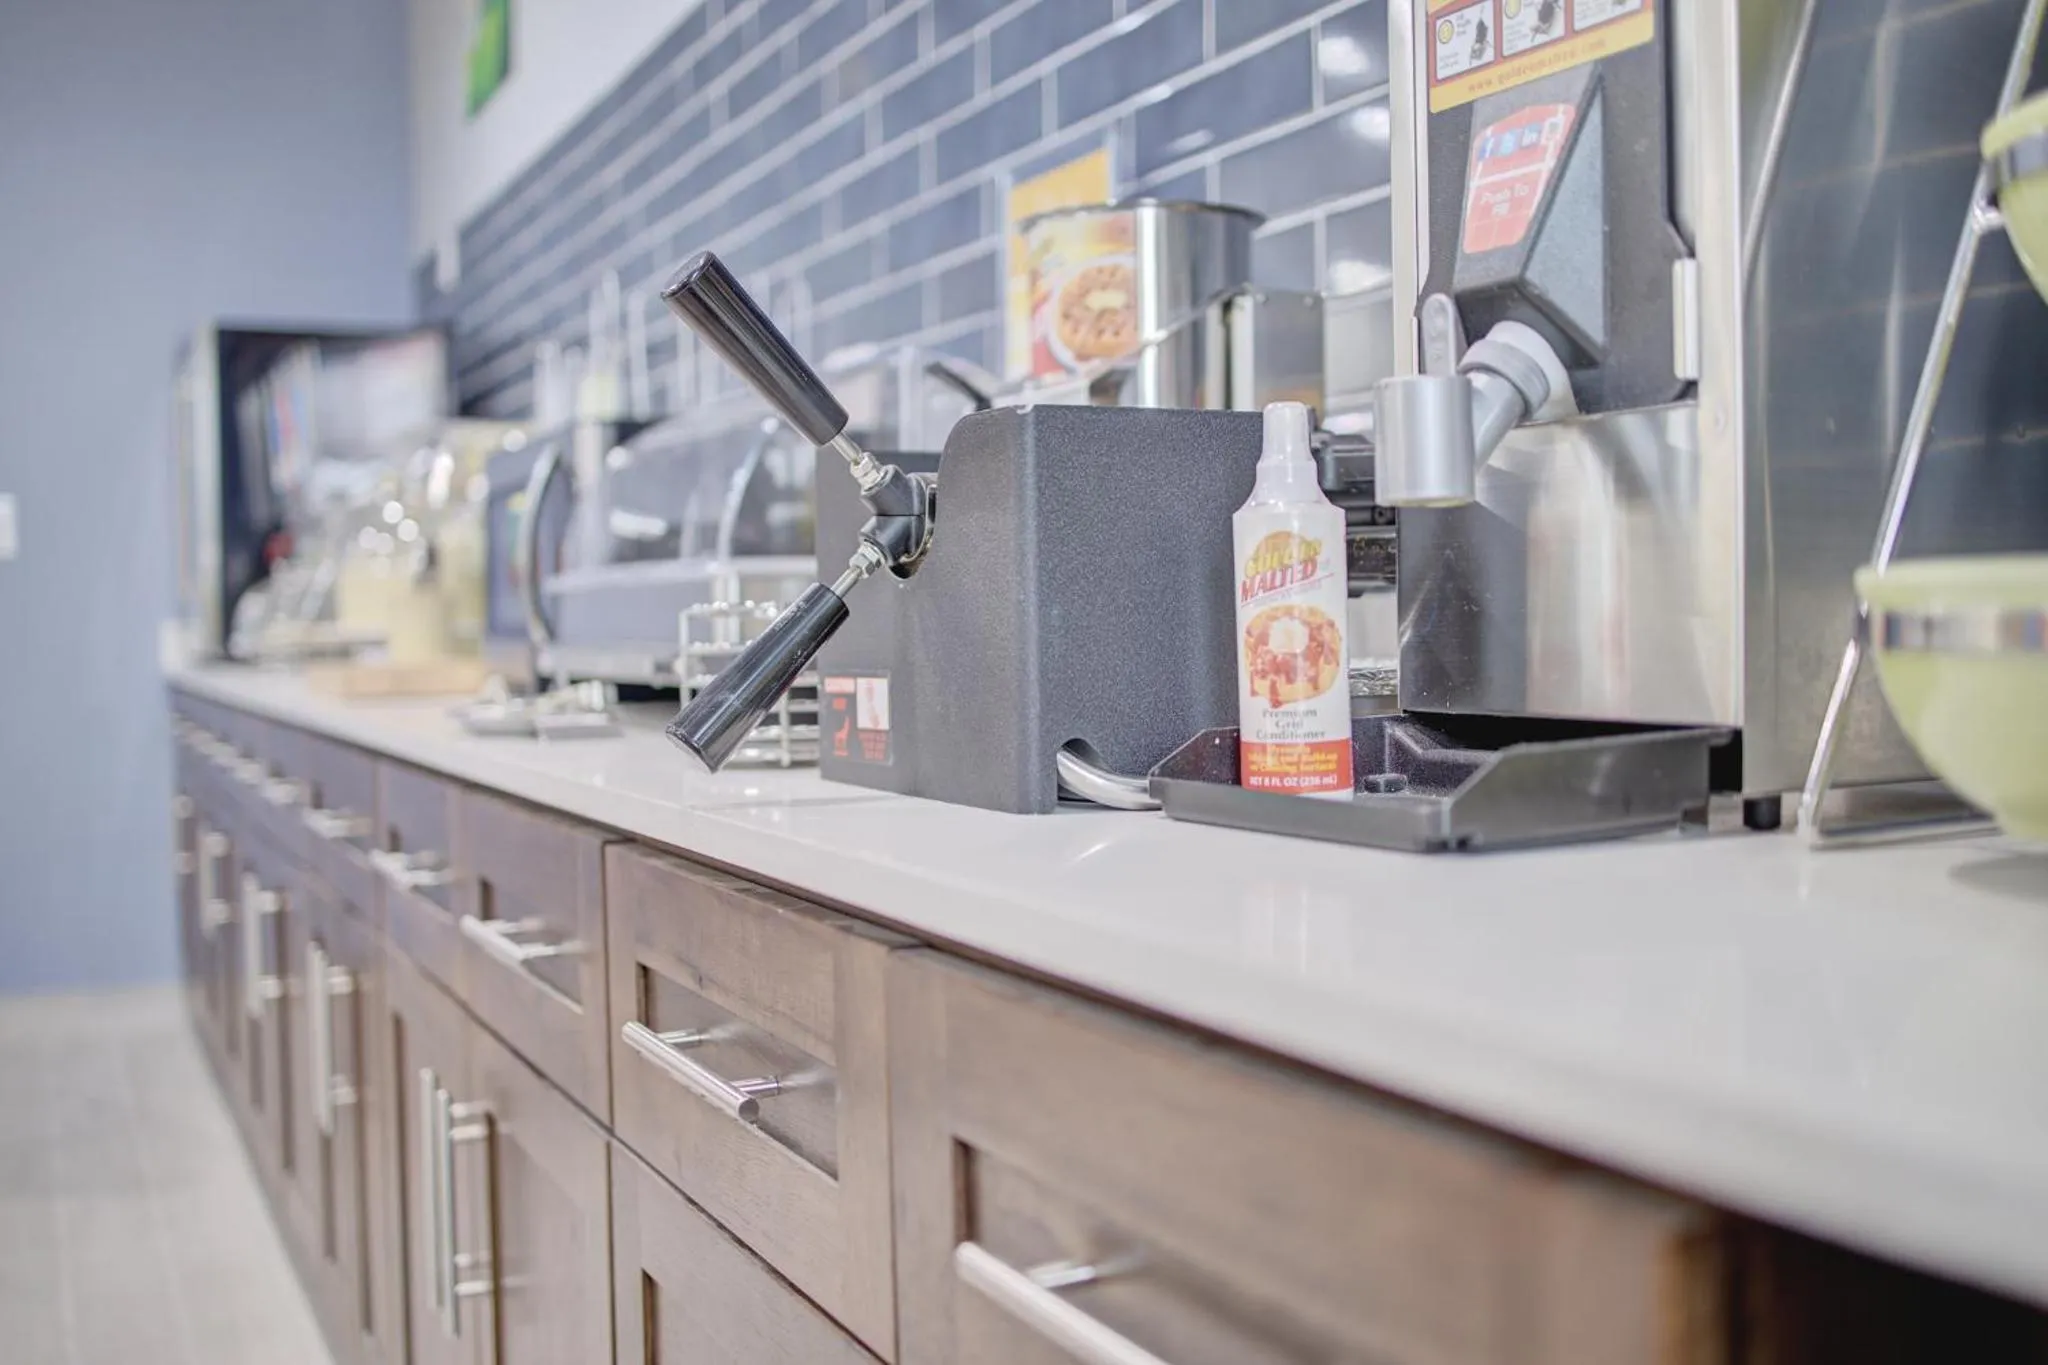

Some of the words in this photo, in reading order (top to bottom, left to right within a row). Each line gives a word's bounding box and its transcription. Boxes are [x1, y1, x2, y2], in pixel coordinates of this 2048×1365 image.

[1240, 555, 1318, 602] MALTED
[1263, 708, 1318, 718] Premium
[1256, 730, 1325, 740] Conditioner
